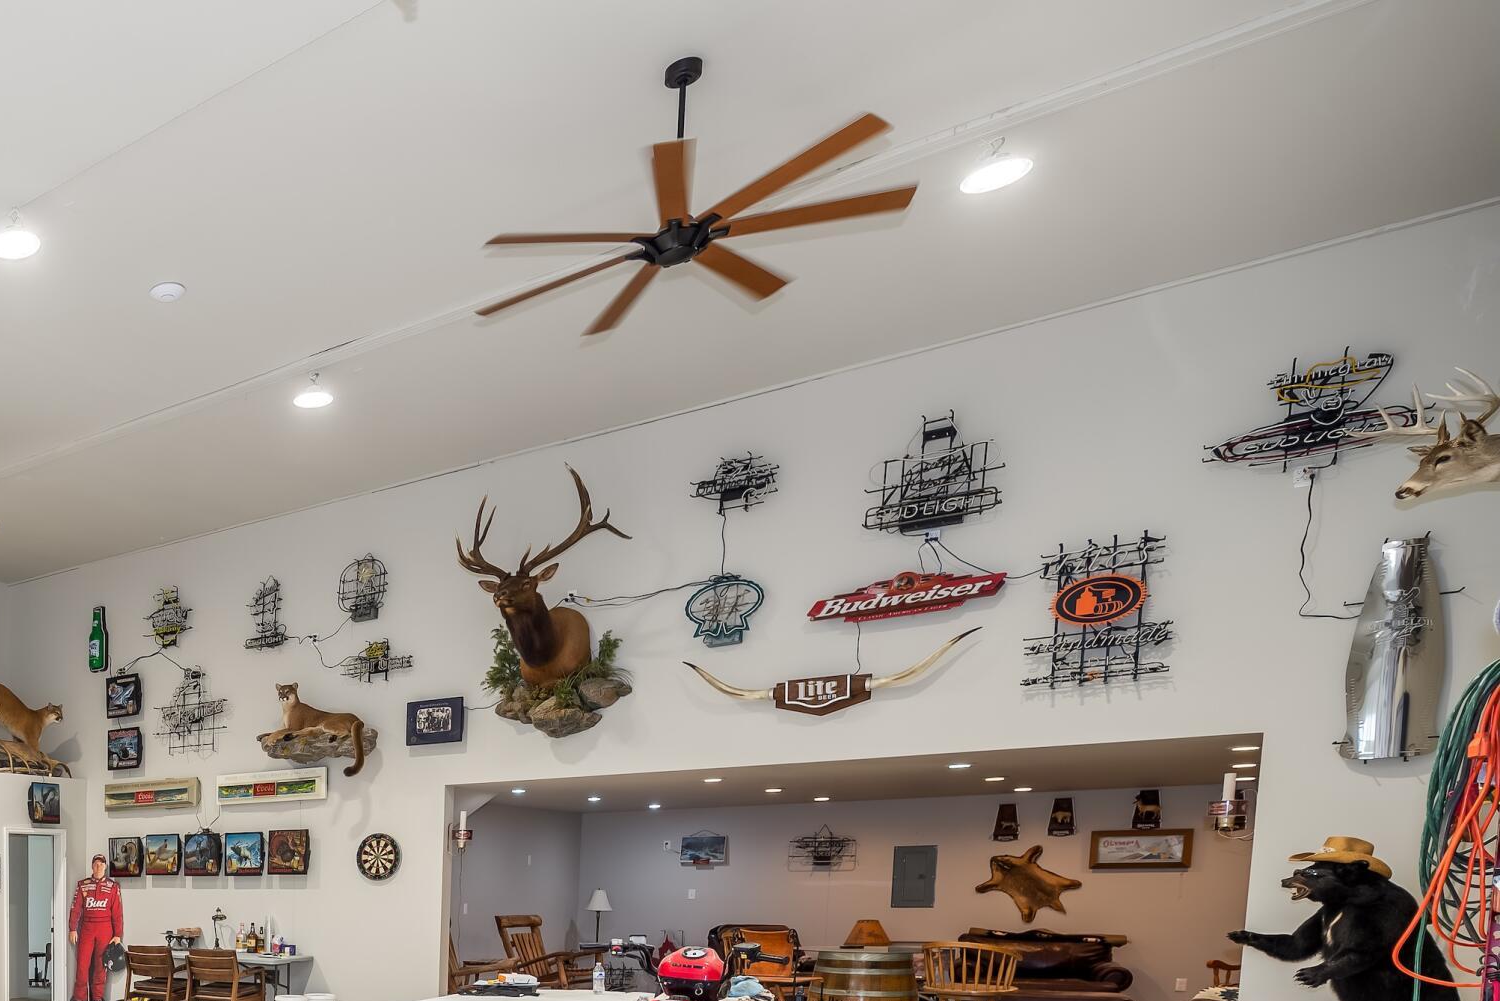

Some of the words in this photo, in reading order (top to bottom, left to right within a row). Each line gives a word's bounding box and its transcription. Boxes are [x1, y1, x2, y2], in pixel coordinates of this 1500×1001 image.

[820, 580, 993, 618] Budweiser
[796, 680, 838, 701] Lite
[255, 784, 275, 793] Coors
[1102, 839, 1141, 849] OLYMPIA
[85, 896, 109, 908] Bud
